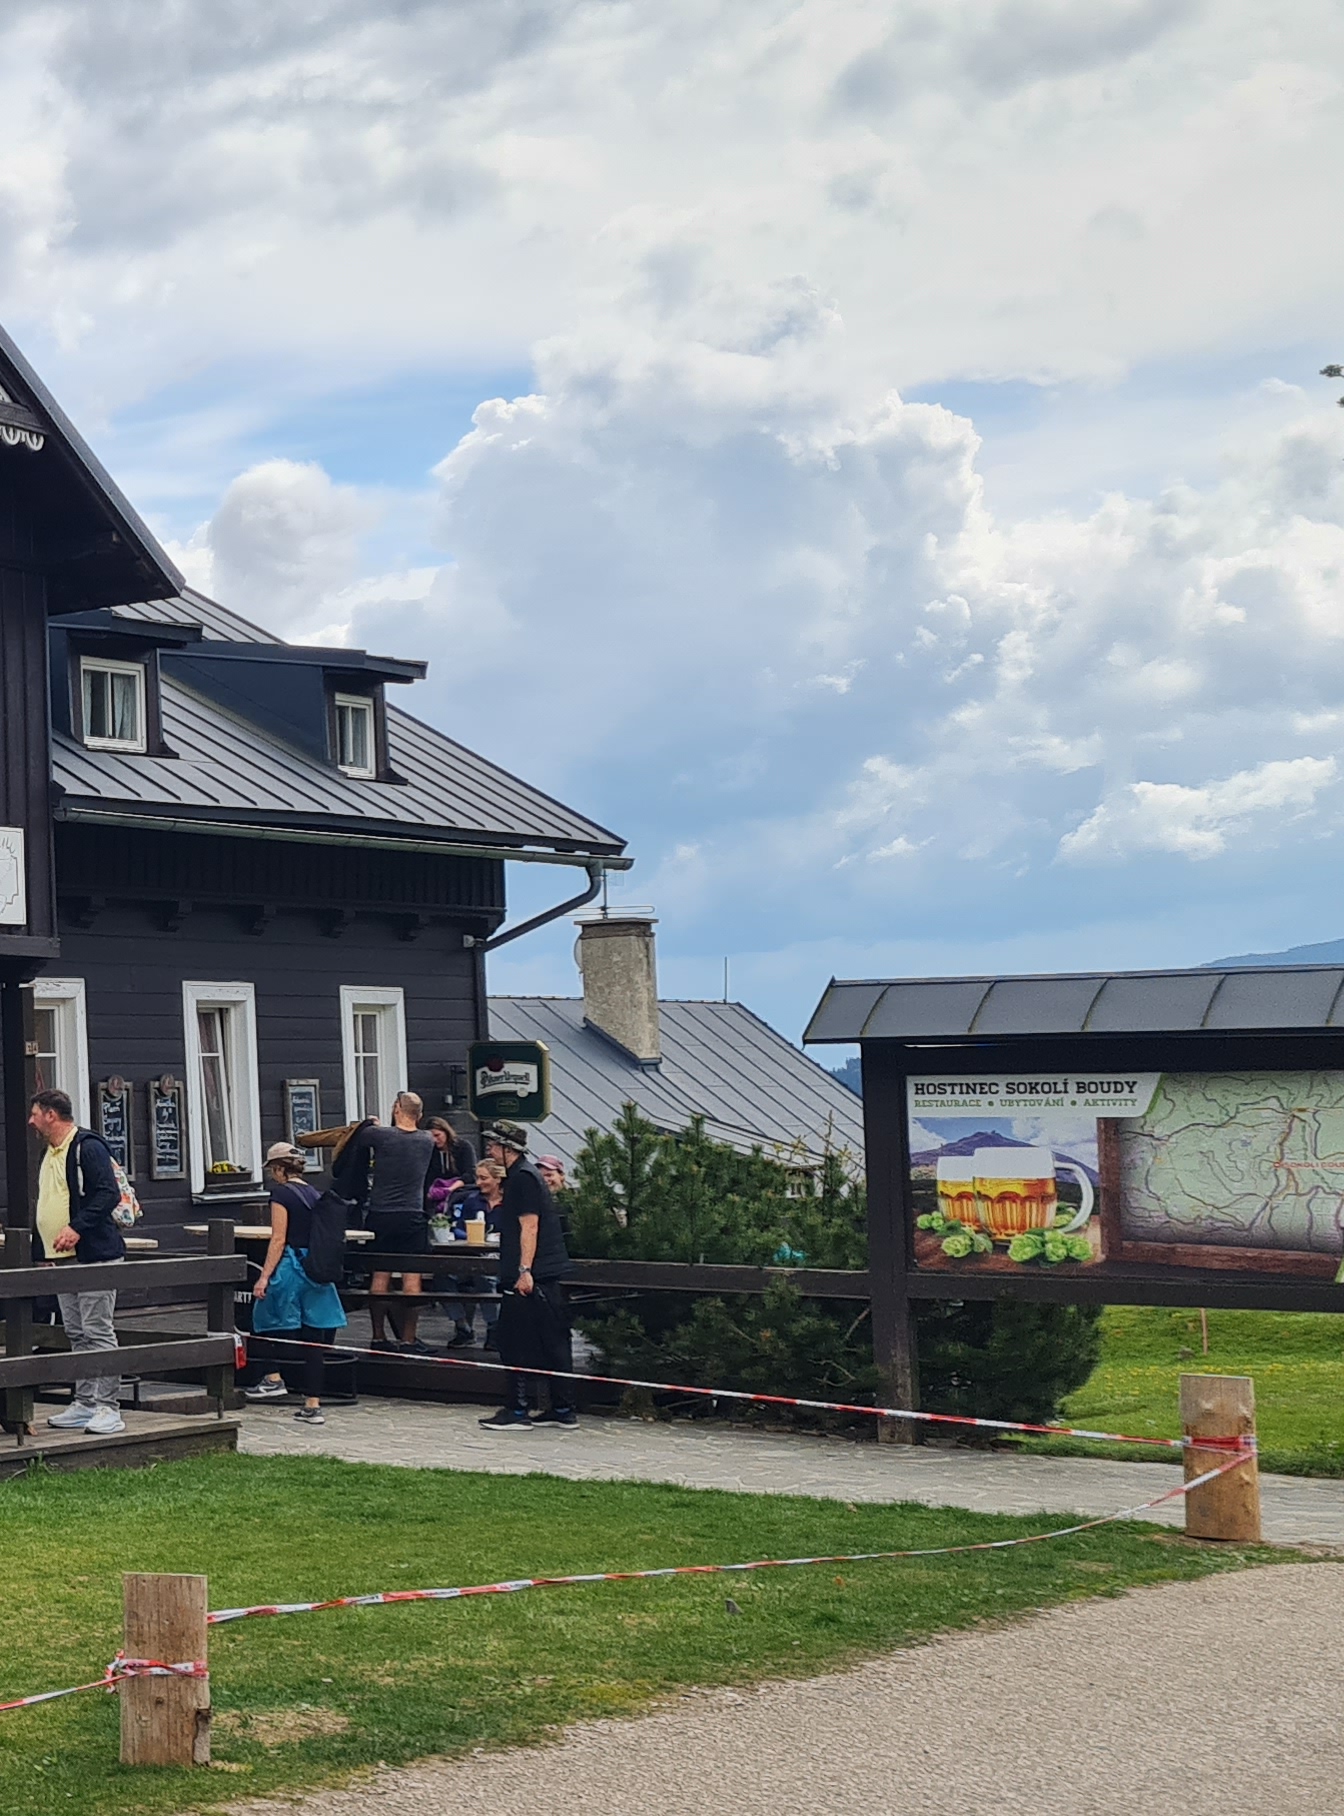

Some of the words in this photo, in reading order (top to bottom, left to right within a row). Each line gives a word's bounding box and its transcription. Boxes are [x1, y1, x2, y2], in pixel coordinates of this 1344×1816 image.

[914, 1082, 1000, 1095] HOSTINEC
[1005, 1078, 1069, 1095] SOKOLÍ
[1076, 1081, 1138, 1095] BOUDY
[914, 1099, 982, 1108] RESTAURACE
[1083, 1098, 1138, 1107] AKTIVITY
